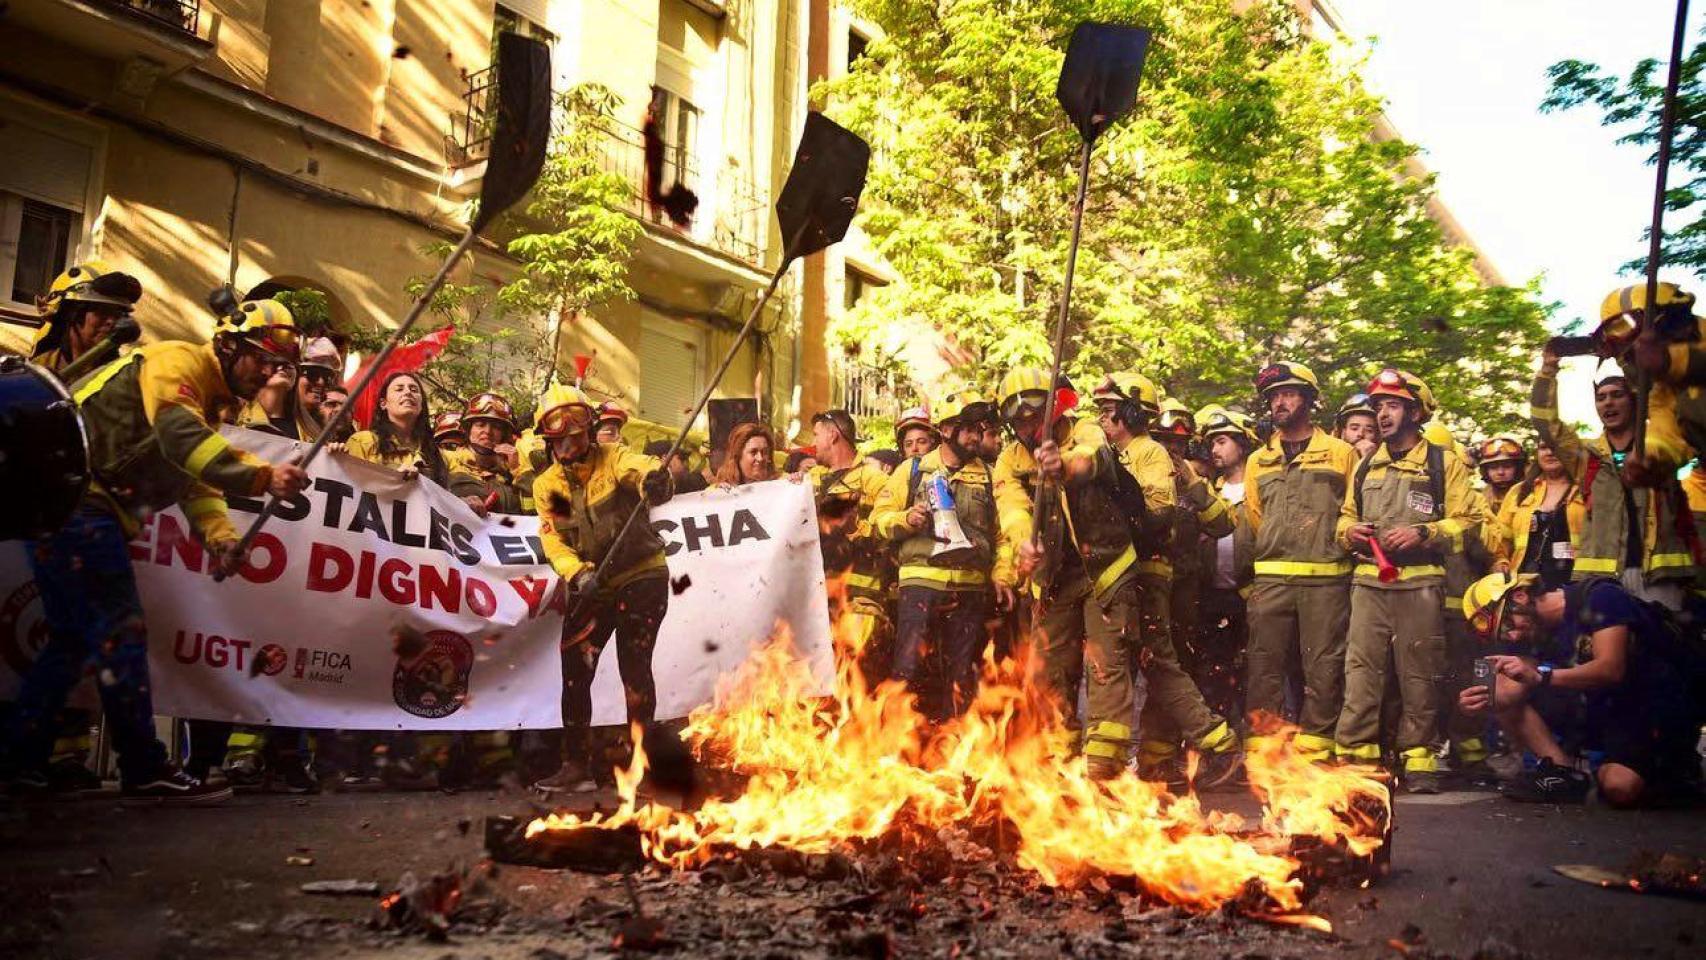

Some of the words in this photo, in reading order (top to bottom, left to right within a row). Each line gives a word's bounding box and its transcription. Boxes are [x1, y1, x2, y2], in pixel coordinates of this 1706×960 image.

[226, 477, 481, 567] STALES
[306, 542, 497, 618] DIGNO
[174, 630, 251, 671] UGT
[311, 650, 352, 670] FICA
[308, 671, 344, 684] Madrid
